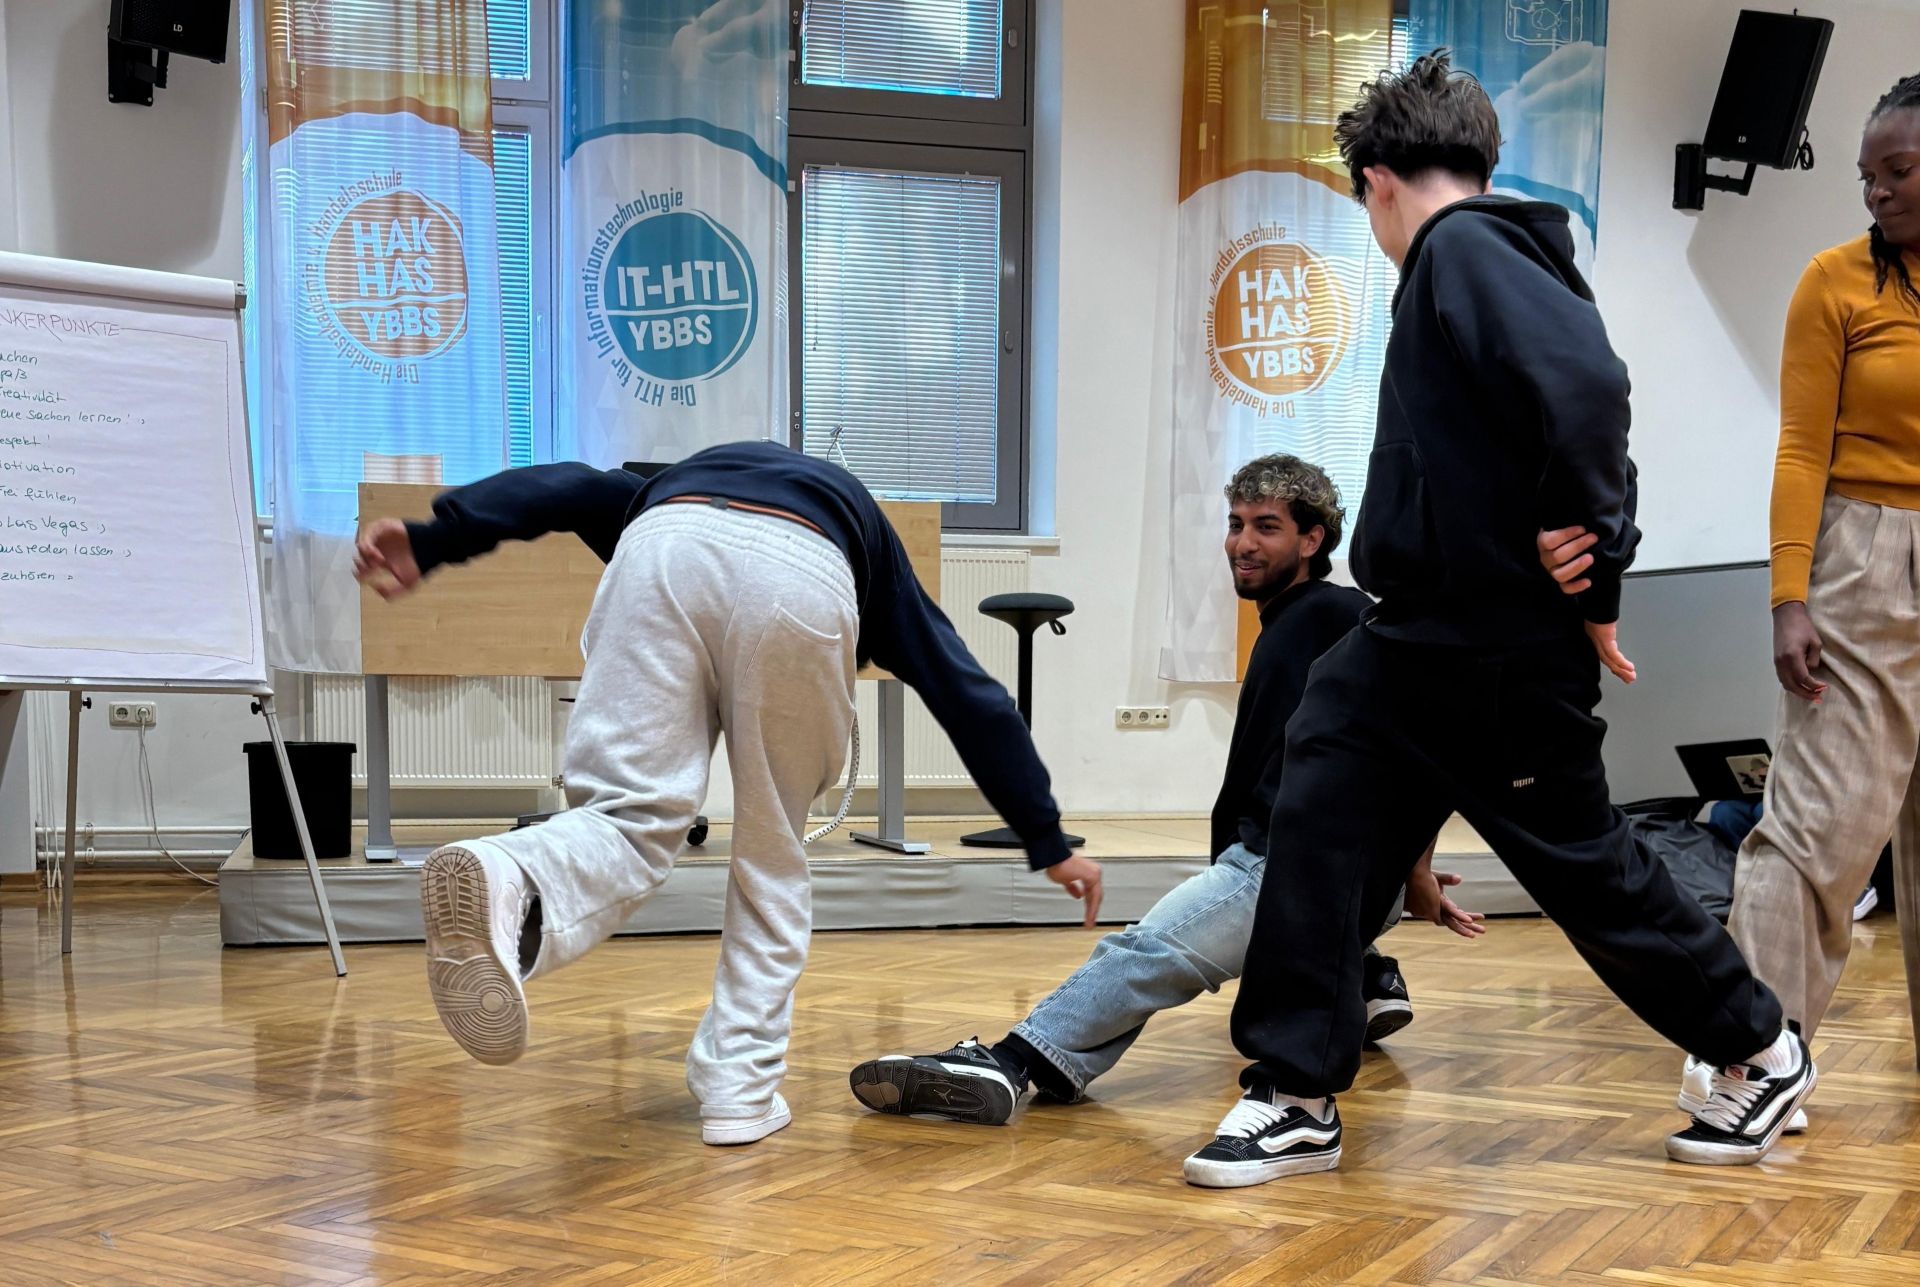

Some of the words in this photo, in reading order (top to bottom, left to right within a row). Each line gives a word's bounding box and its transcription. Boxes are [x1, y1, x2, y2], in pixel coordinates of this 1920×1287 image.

[173, 24, 183, 32] LD
[308, 167, 403, 240] Handelsschule
[353, 216, 436, 258] HAK
[1209, 220, 1286, 290] Handelsschule
[357, 257, 434, 298] HAS
[582, 187, 683, 359] Informationstechnologie
[617, 260, 740, 307] IT-HTL
[1238, 265, 1312, 303] HAK
[302, 263, 391, 384] Handelsakademie
[360, 306, 441, 342] YBBS
[628, 314, 712, 351] YBBS
[1240, 301, 1312, 339] HAS
[397, 364, 420, 384] Die
[611, 358, 633, 388] für
[1242, 347, 1314, 379] YBBS
[634, 376, 665, 407] HTL
[671, 384, 697, 407] Die
[26, 409, 71, 422] Sachen
[1272, 400, 1295, 418] Die
[0, 460, 76, 475] otivation
[25, 487, 77, 504] fühlen
[7, 515, 38, 531] Las
[41, 515, 88, 537] Vegas
[74, 544, 113, 556] lassen
[1, 570, 55, 581] zuhören
